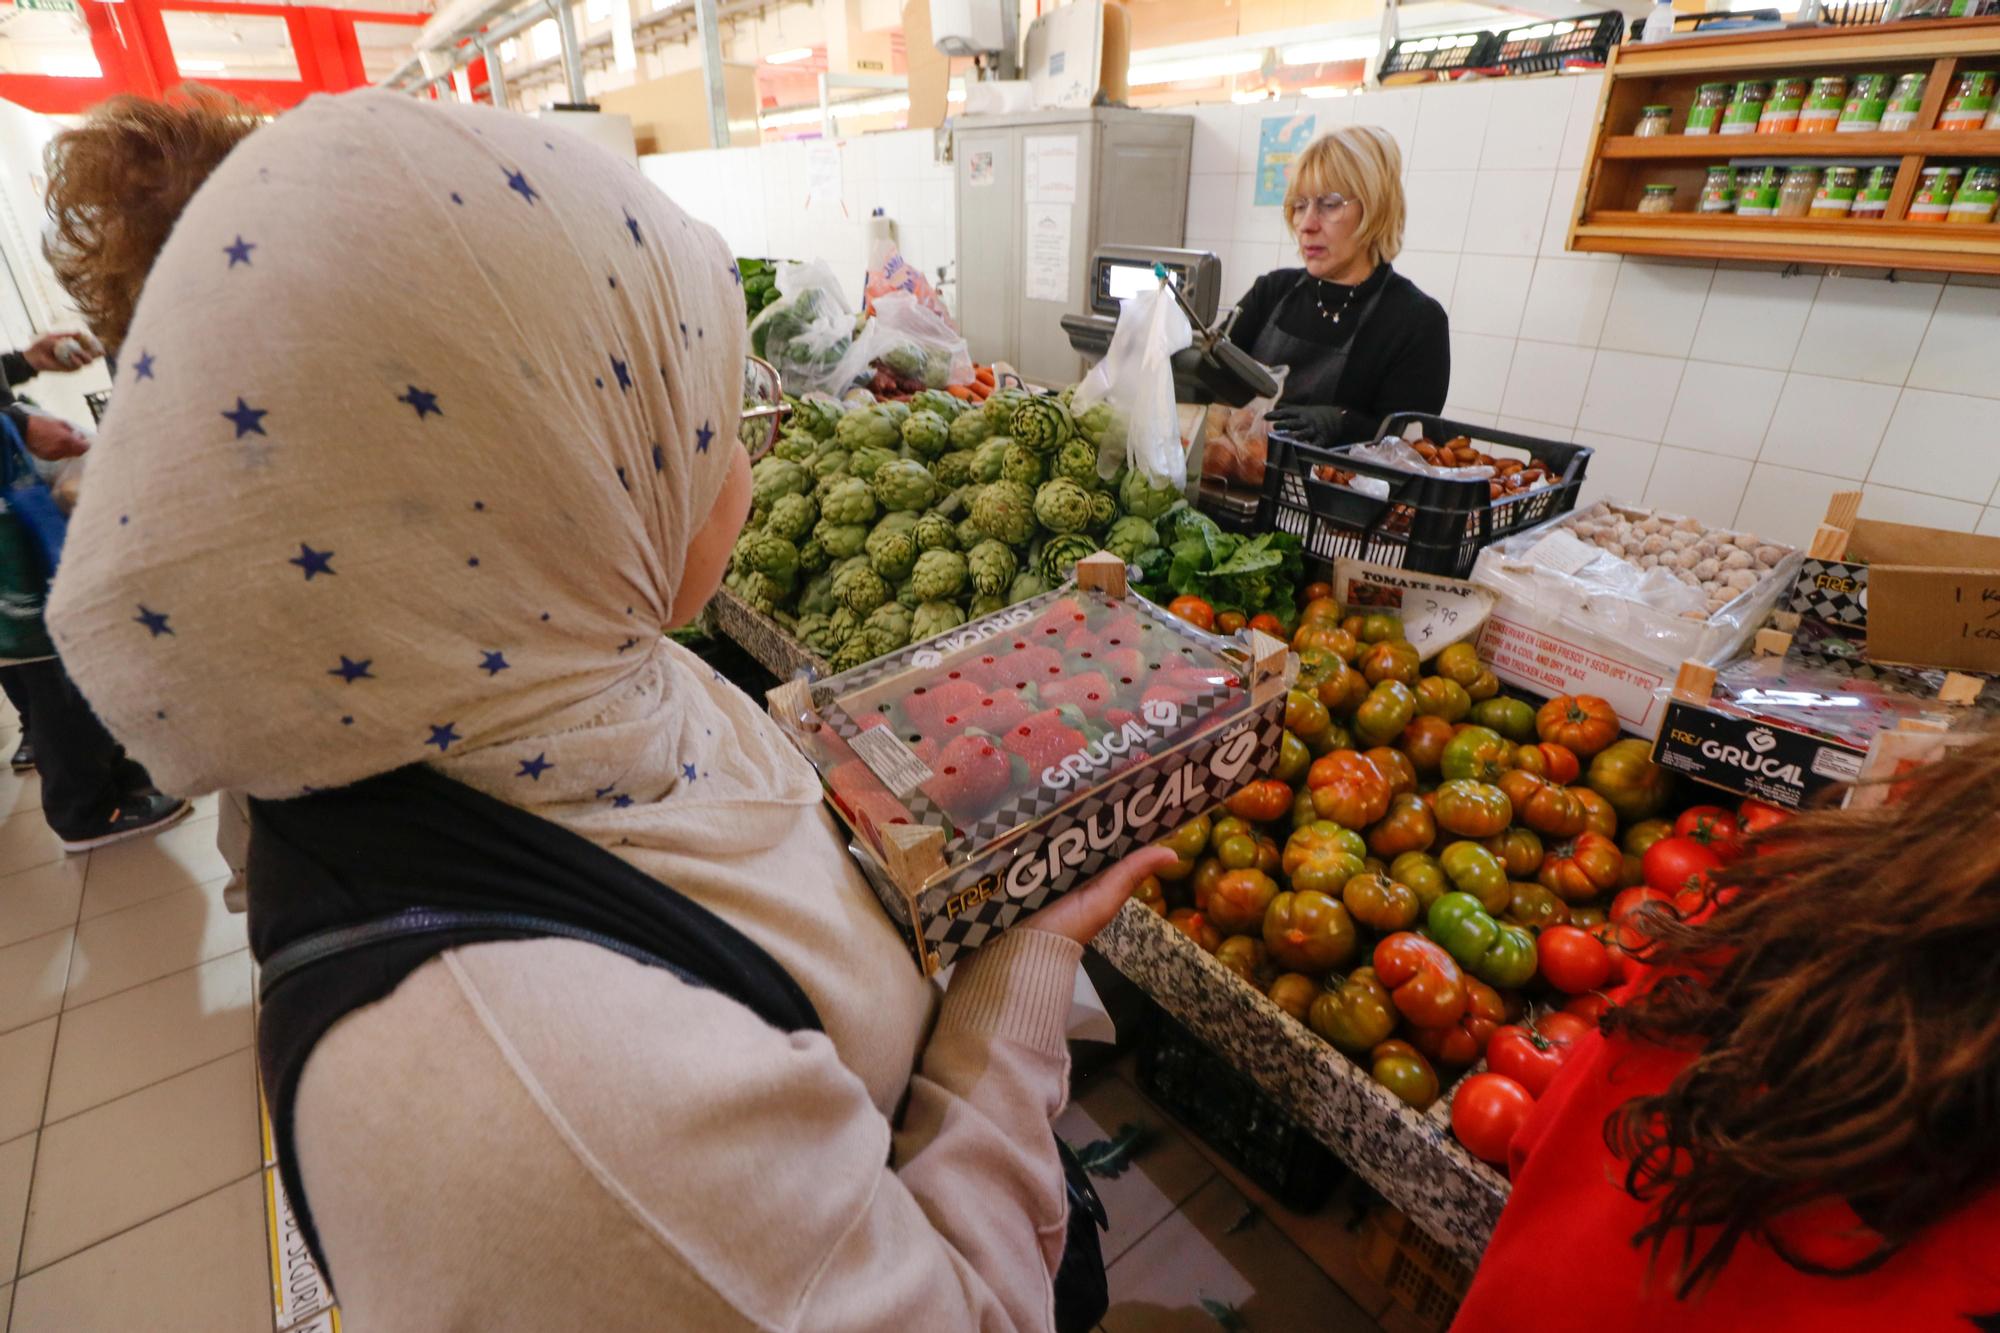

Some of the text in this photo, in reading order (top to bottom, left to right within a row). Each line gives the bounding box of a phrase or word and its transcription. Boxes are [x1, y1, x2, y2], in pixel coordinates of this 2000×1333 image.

[1362, 571, 1472, 598] TOMATE RAF
[934, 608, 1033, 652] GRUCAL
[1488, 620, 1526, 640] CONSERVAR
[1525, 633, 1536, 645] EN
[1536, 639, 1559, 654] LUGAR
[1557, 646, 1584, 664] FRESCO
[1590, 659, 1610, 674] SECO
[1485, 633, 1505, 648] STORE
[1517, 646, 1534, 661] COOL
[1536, 654, 1550, 667] AND
[1549, 658, 1564, 671] DRY
[1564, 665, 1587, 682] PLACE
[1511, 657, 1540, 677] TROCKEN
[1539, 672, 1565, 688] LAGERN
[1042, 719, 1156, 790] GRUCAL
[1701, 740, 1805, 788] GRUCAL
[1005, 762, 1206, 898] GRUCAL
